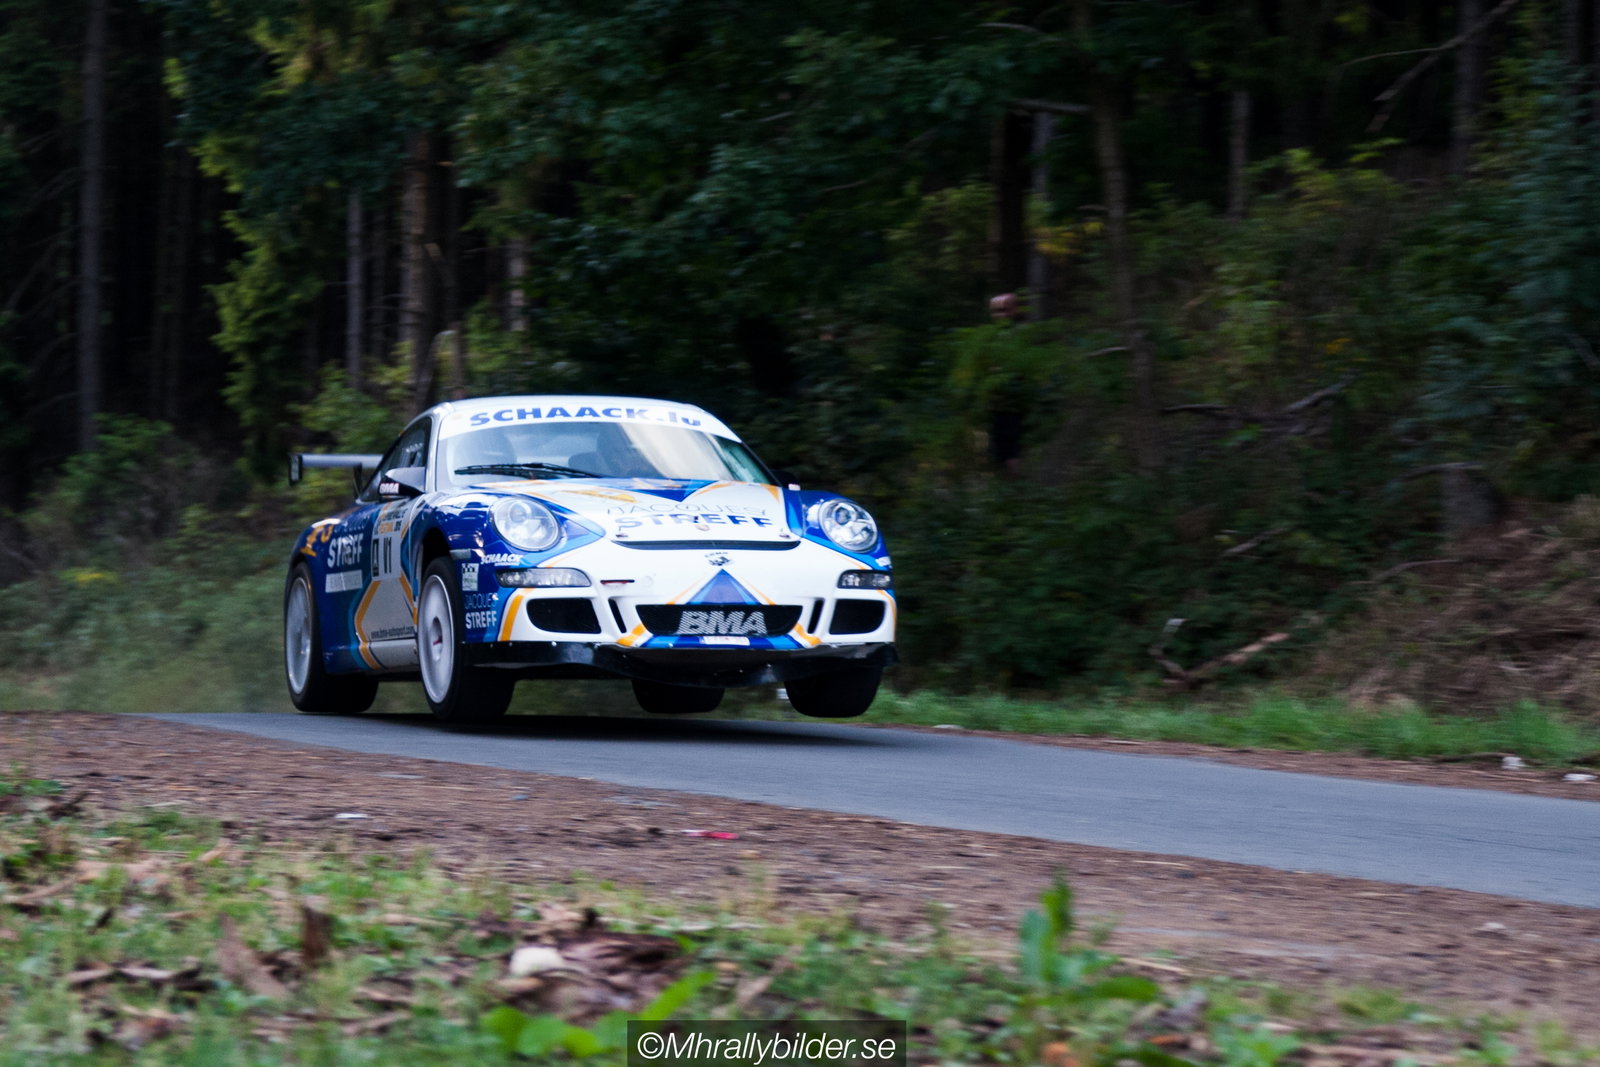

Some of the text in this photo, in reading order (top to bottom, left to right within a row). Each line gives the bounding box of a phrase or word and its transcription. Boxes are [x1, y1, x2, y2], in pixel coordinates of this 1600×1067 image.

[470, 407, 702, 427] SCHAACK.lu
[615, 513, 773, 528] STREFF
[328, 533, 363, 568] STREFF
[481, 553, 523, 564] SCHAACK
[466, 611, 497, 629] STREFF
[674, 610, 769, 635] BMA
